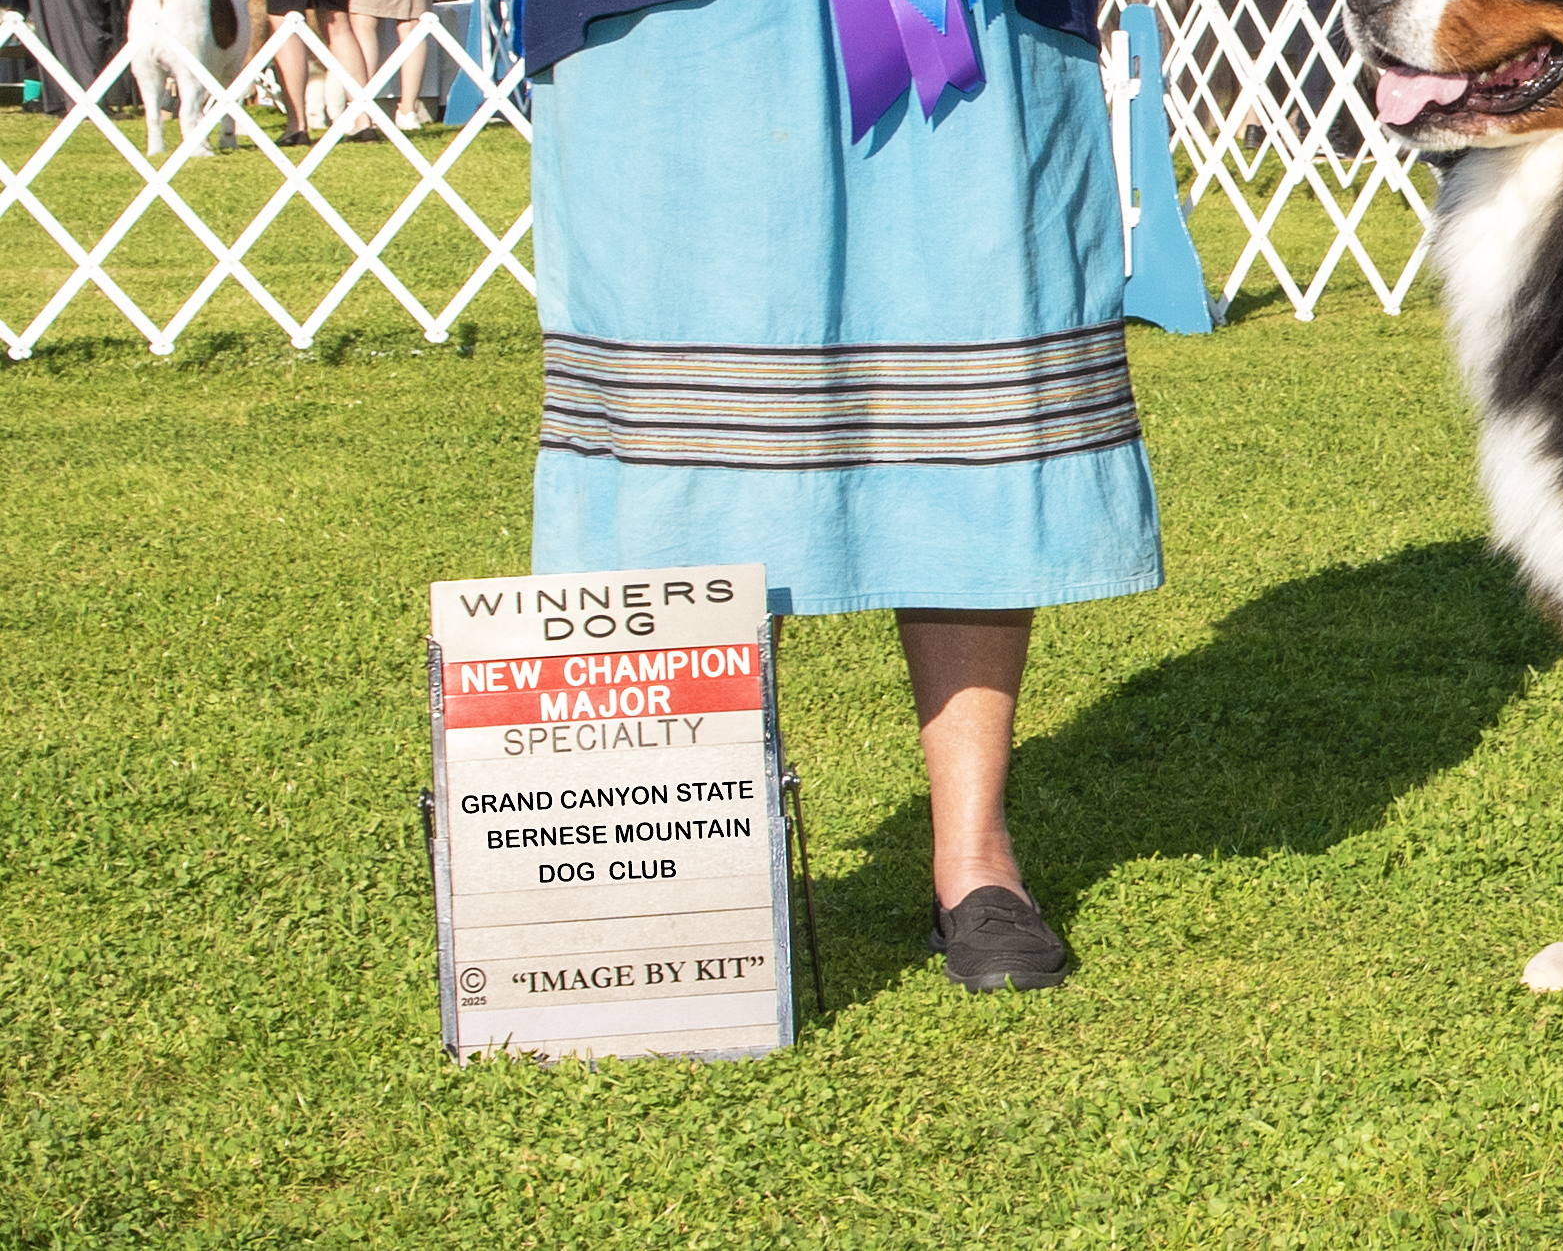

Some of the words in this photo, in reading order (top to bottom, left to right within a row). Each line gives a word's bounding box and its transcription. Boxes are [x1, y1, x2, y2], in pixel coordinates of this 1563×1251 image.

[460, 578, 735, 618] WINNERS
[543, 612, 656, 642] DOG
[461, 660, 542, 694] NEW
[563, 646, 751, 687] CHAMPION
[540, 684, 672, 722] MAJOR
[503, 716, 705, 757] SPECIALTY
[461, 791, 553, 815] GRAND
[560, 784, 668, 810] CANYON
[676, 779, 755, 803] STATE
[487, 824, 608, 850] BERNESE
[615, 817, 751, 844] MOUNTAIN
[538, 861, 595, 884] DOG
[608, 859, 677, 881] CLUB
[511, 964, 635, 994] “IMAGE
[644, 961, 687, 985] BY
[694, 955, 765, 982] KIT”
[461, 995, 487, 1007] 2025
